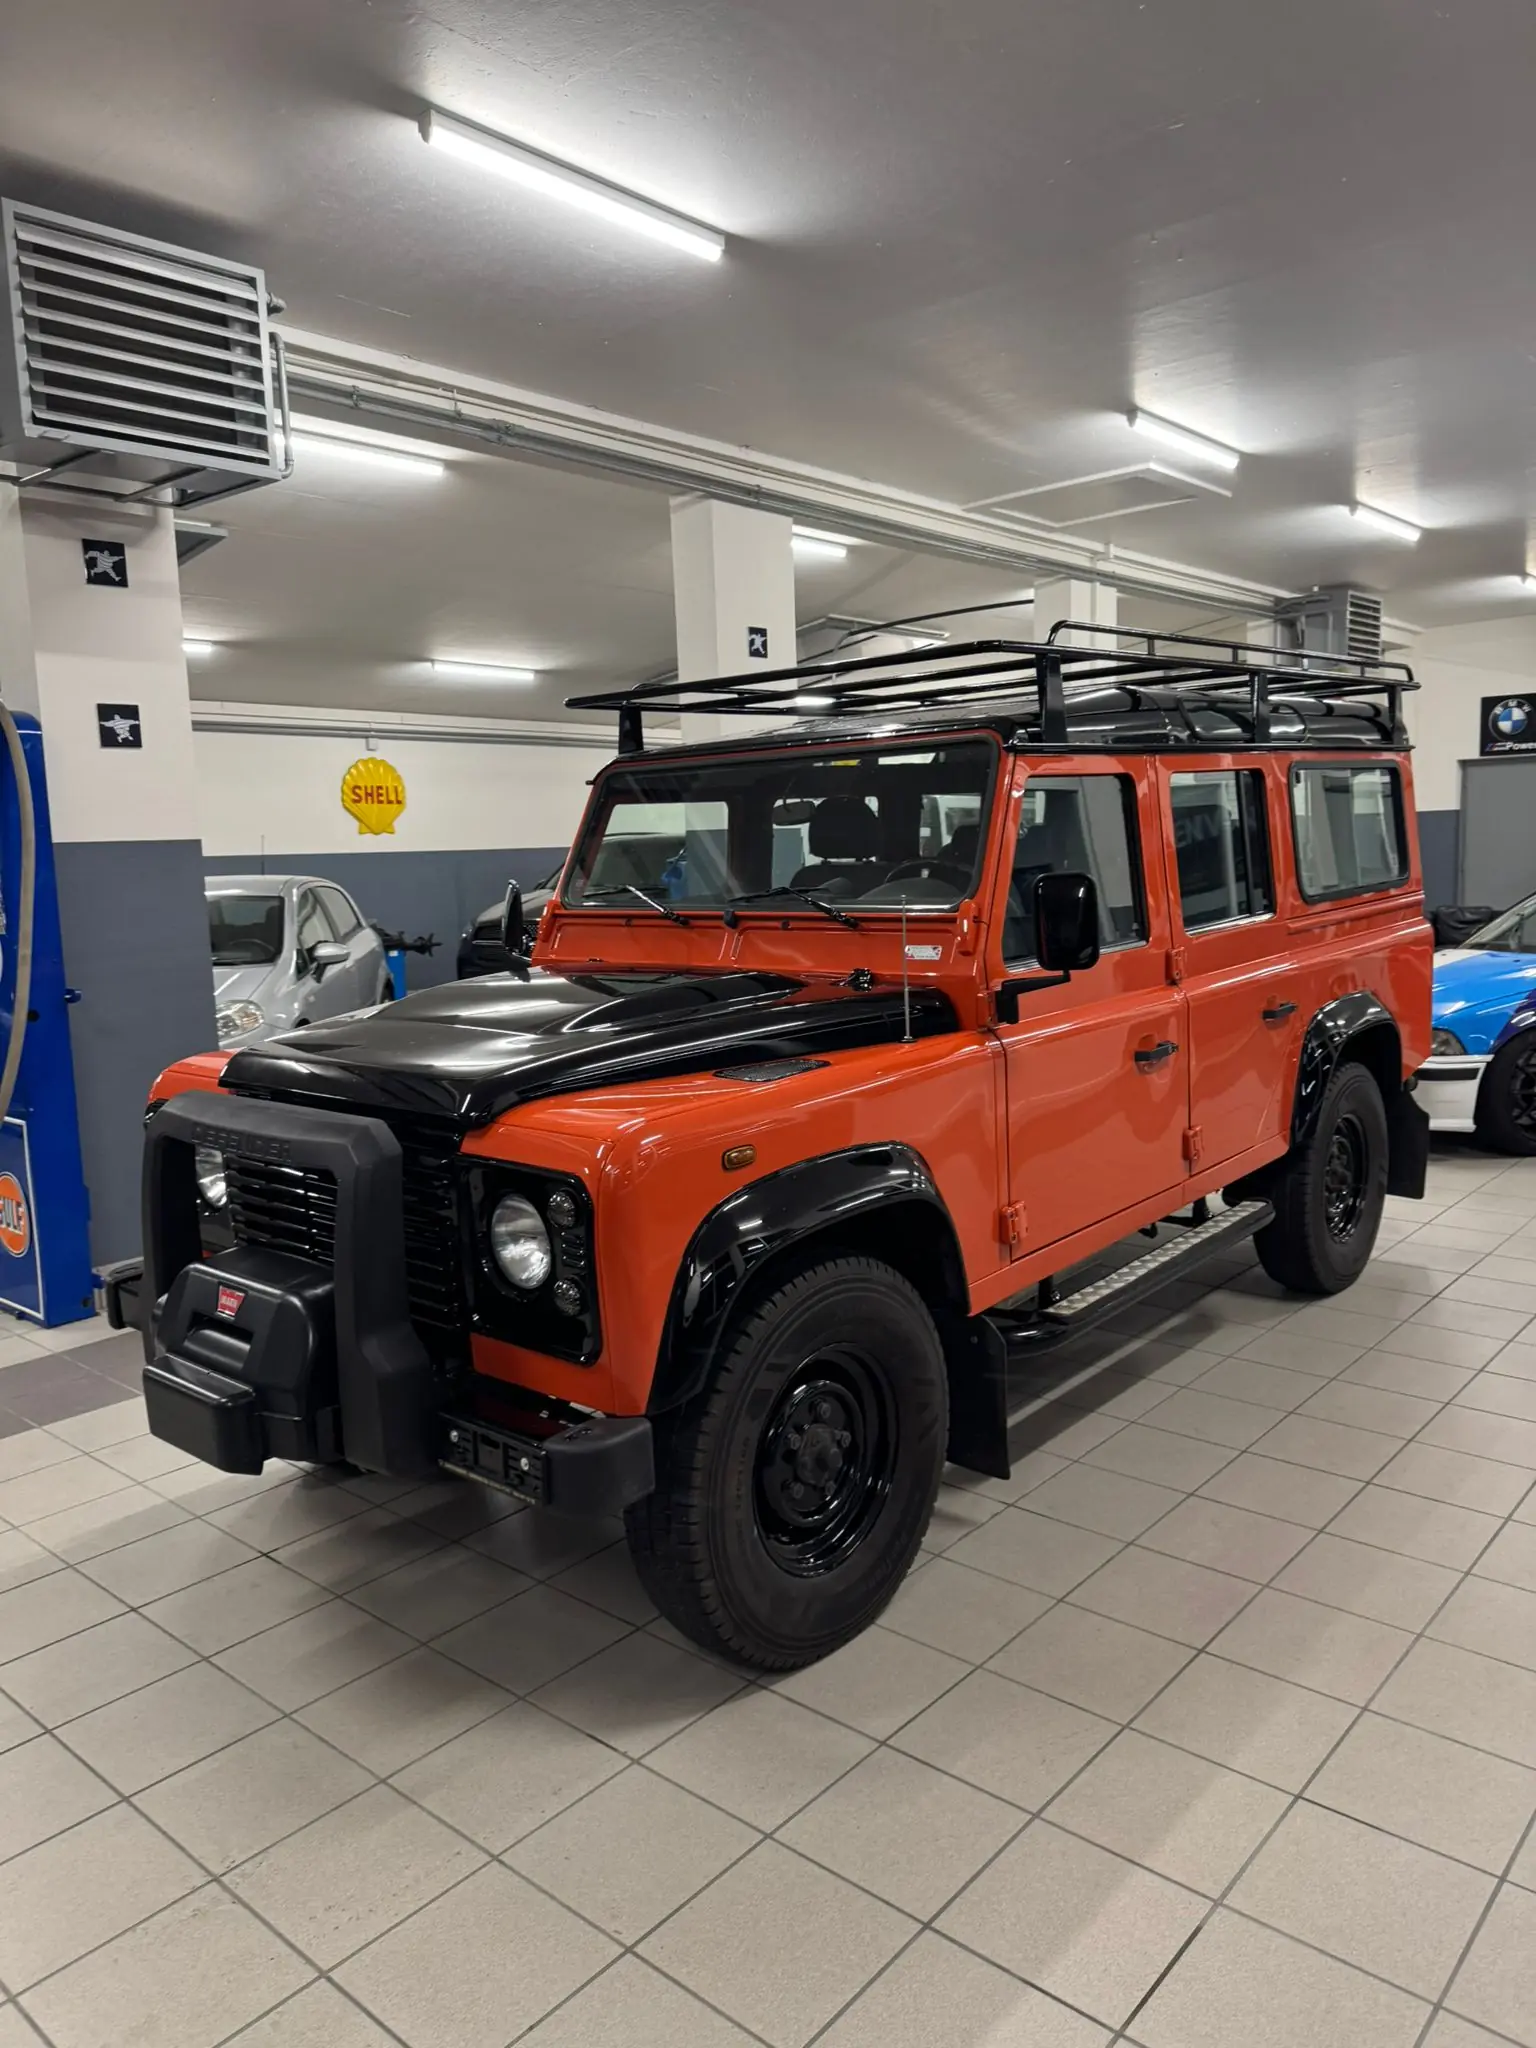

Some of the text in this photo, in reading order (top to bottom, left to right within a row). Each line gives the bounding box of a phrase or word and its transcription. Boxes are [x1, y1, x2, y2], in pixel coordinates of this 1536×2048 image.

[1494, 699, 1532, 714] BMW
[351, 784, 403, 805] SHELL
[191, 1121, 291, 1164] DEFENDER
